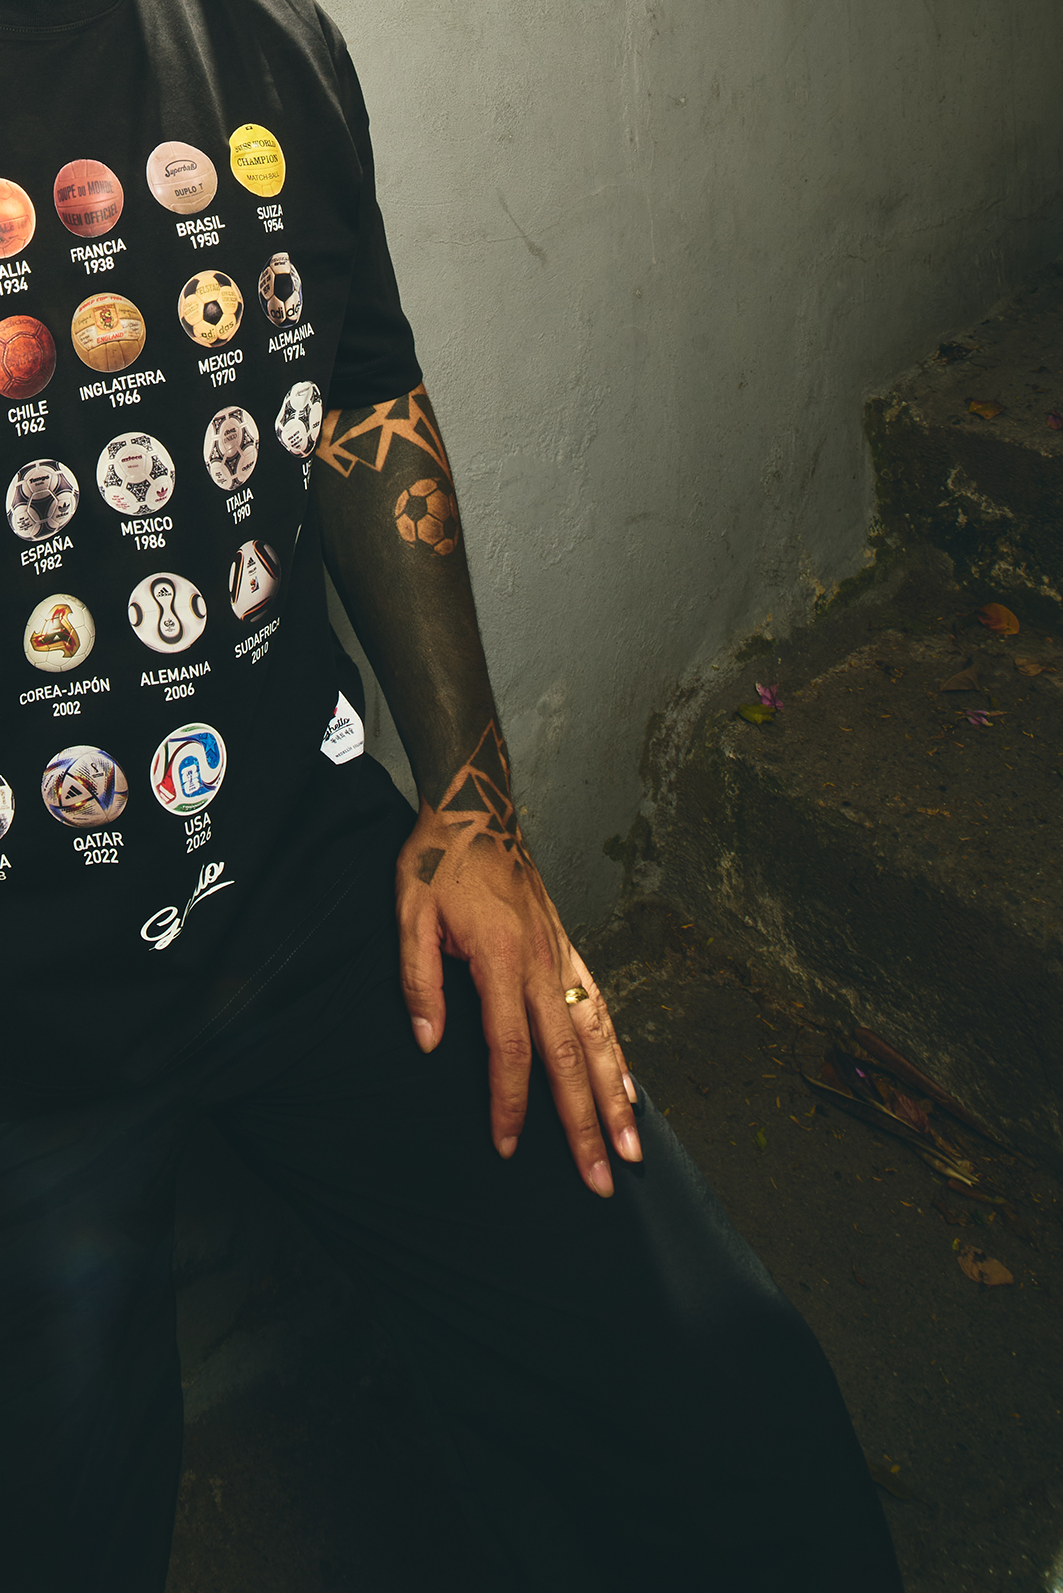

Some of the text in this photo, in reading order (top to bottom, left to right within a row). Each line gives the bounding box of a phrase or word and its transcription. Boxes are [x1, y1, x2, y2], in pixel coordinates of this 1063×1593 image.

[174, 186, 197, 197] DUPLO
[257, 204, 283, 220] SUIZA
[176, 215, 226, 238] BRASIL
[263, 218, 284, 233] 1954
[70, 238, 127, 263] FRANCIA
[190, 232, 220, 250] 1950
[83, 256, 115, 275] 1938
[268, 322, 315, 354] ALEMANIA
[198, 349, 244, 376] MEXICO
[282, 342, 306, 363] 1974
[79, 369, 166, 401] INGLATERRA
[210, 368, 236, 388] 1970
[109, 390, 141, 408] 1966
[7, 400, 49, 424] CHILE
[15, 417, 46, 437] 1962
[226, 488, 254, 513] ITALIA
[233, 503, 251, 525] 1990
[121, 516, 173, 536] MEXICO
[20, 535, 74, 566] ESPAÑA
[134, 533, 166, 550] 1986
[34, 554, 62, 575] 1982
[251, 641, 269, 665] 2010
[140, 660, 212, 687] ALEMANIA
[19, 676, 110, 705] COREA-JAPÓN
[164, 682, 195, 702] 2006
[52, 700, 81, 717] 2002
[184, 811, 212, 836] USA
[73, 831, 124, 852] QATAR
[185, 826, 212, 854] 2026
[83, 848, 119, 866] 2022
